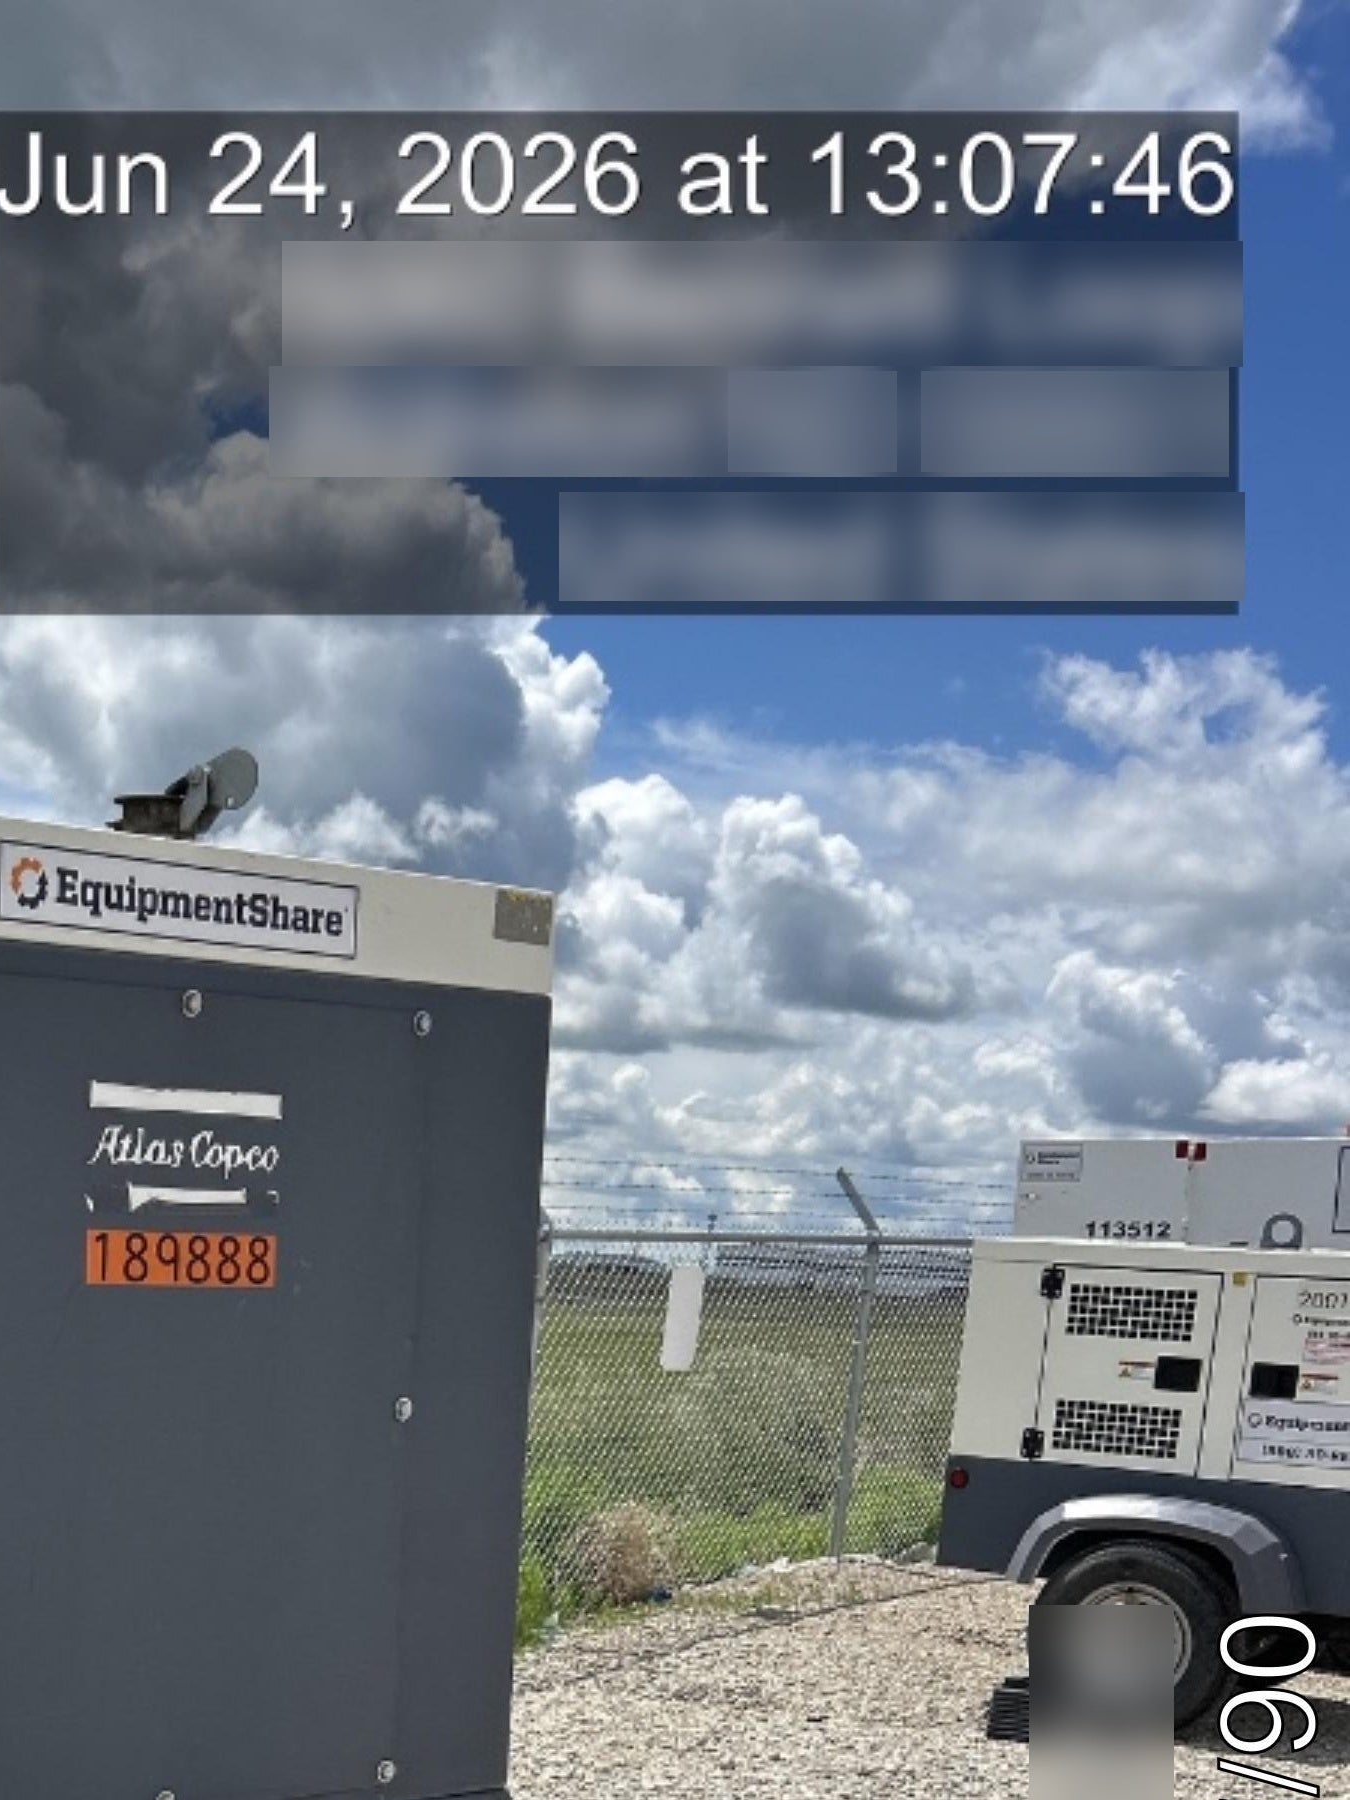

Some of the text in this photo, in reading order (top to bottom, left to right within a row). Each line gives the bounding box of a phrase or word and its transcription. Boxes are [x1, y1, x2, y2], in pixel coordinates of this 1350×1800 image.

[55, 867, 344, 937] EquipmentShare
[87, 1124, 280, 1180] Atlas Copco
[1085, 1220, 1171, 1239] 113512
[95, 1231, 270, 1285] 189888
